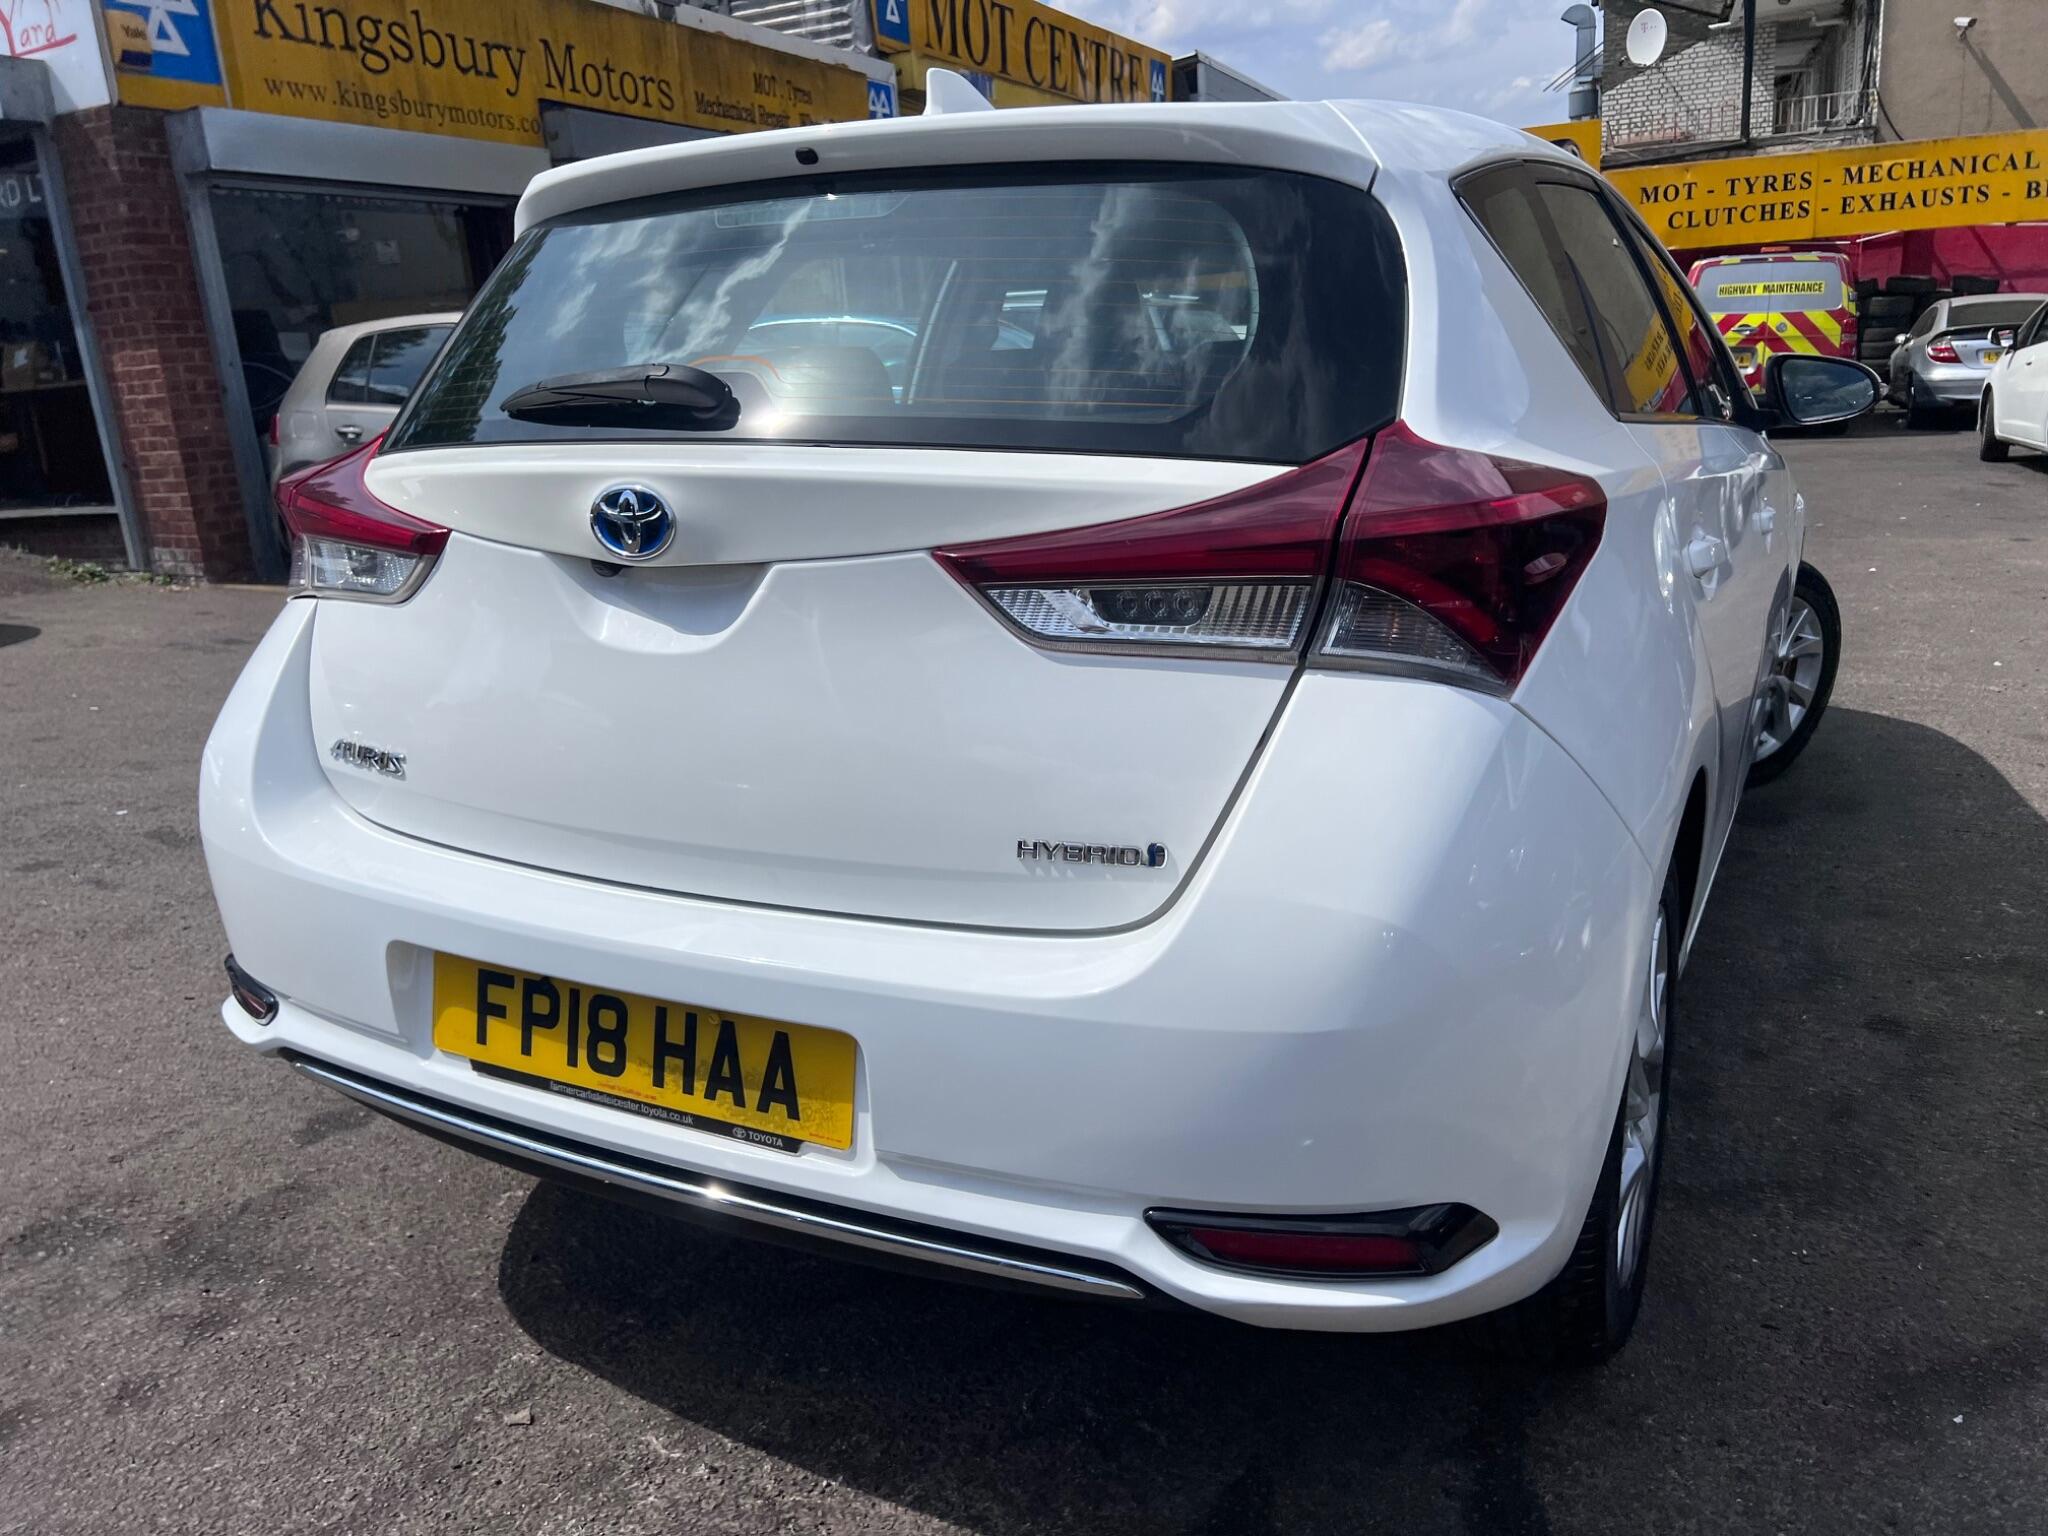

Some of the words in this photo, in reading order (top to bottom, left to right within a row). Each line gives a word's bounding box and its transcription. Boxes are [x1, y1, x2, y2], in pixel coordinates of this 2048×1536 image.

[254, 0, 525, 97] Kingsbury
[539, 38, 675, 112] Motors
[925, 0, 1015, 77] MOT
[1024, 16, 1145, 103] CENTRE
[753, 72, 777, 98] MOT
[1640, 182, 1698, 204] MOT
[1725, 171, 1813, 196] TYRES
[1843, 151, 2040, 186] MECHANICAL
[1668, 200, 1811, 230] CLUTCHES
[1840, 184, 1990, 215] EXHAUSTS
[1719, 284, 1757, 296] HIGHWAY
[1762, 282, 1823, 294] MAINTENANCE
[330, 739, 407, 778] AURIS
[1016, 839, 1141, 867] HYBRID
[476, 968, 629, 1077] FP18
[652, 1006, 801, 1121] HAA
[748, 1131, 784, 1147] TOYOTA
